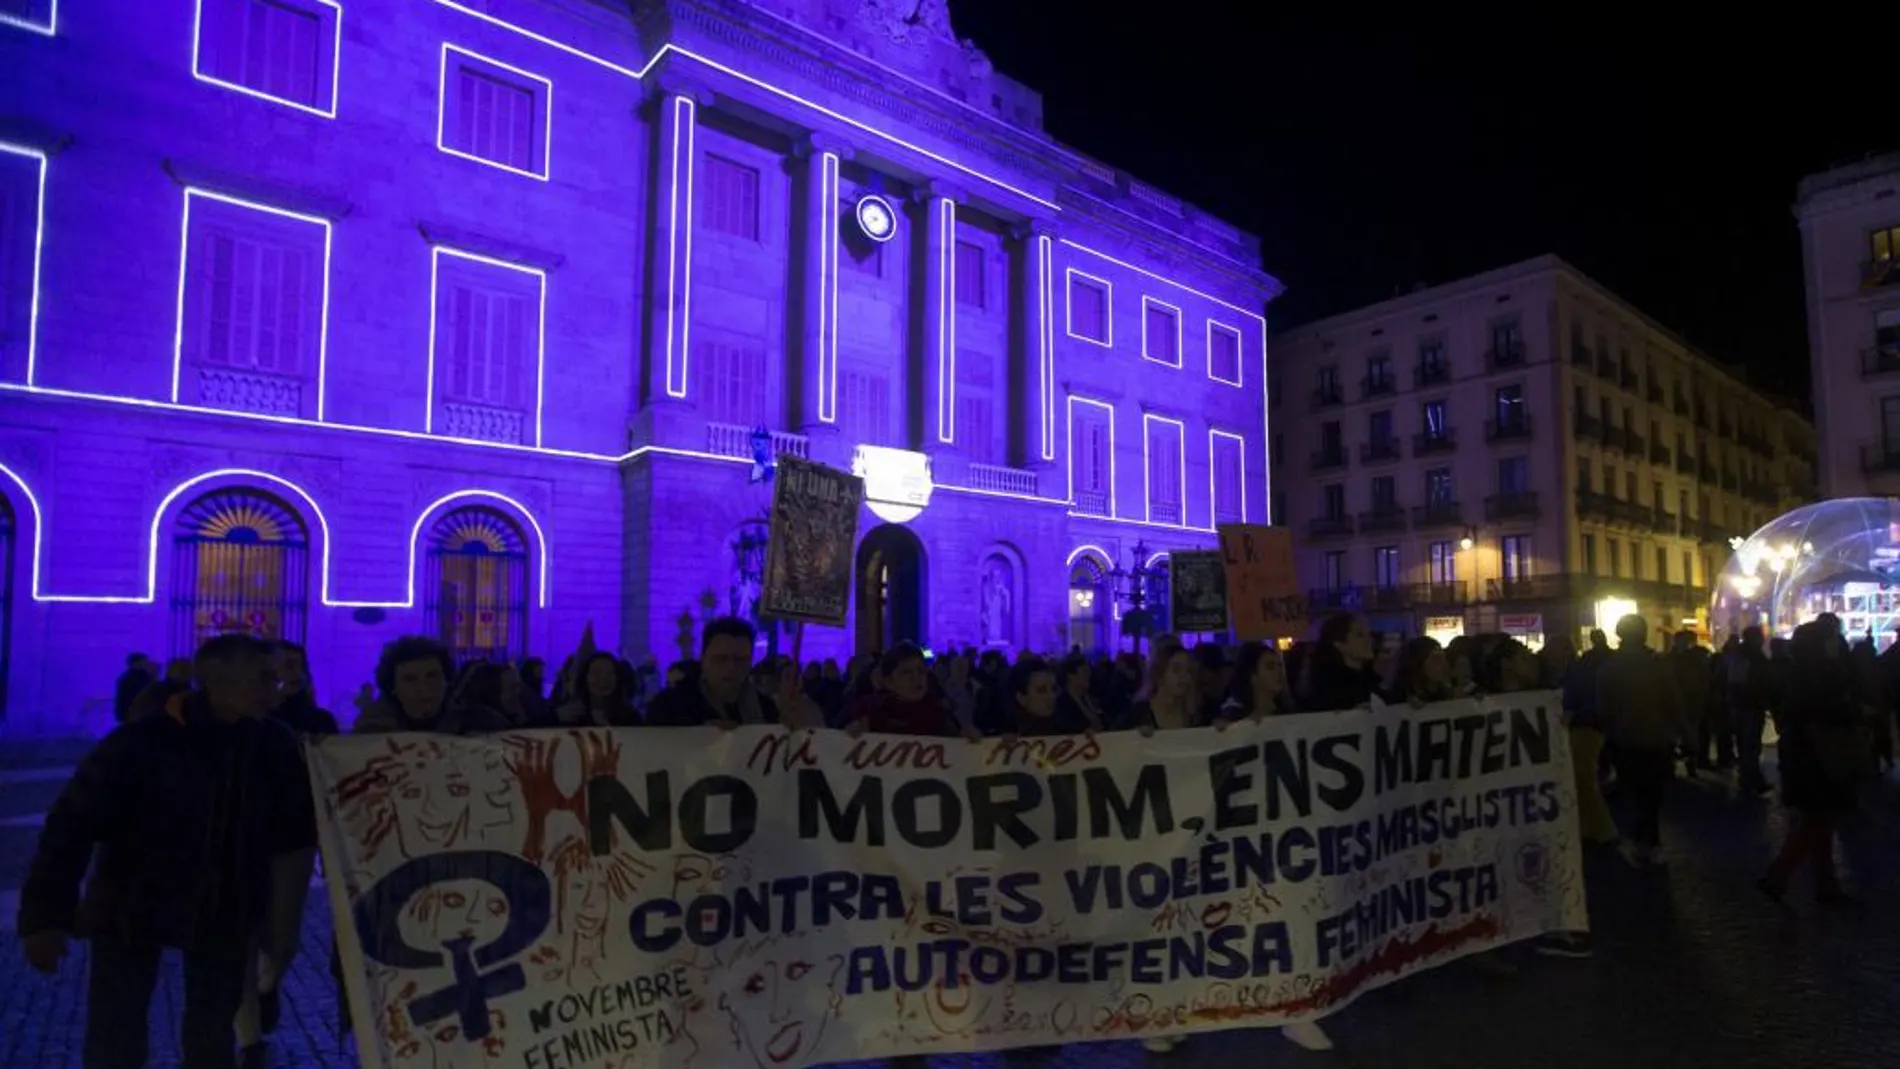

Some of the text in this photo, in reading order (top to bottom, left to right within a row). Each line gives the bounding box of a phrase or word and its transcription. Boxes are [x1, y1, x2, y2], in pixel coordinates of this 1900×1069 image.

[588, 706, 1550, 857] NO MORIM, ENS MATEN
[747, 729, 817, 777] ni
[845, 737, 951, 769] una
[629, 871, 906, 953] CONTRA
[926, 872, 1043, 926] LES
[1064, 819, 1373, 915] VIOLÈNCIES
[846, 863, 1498, 995] AUTODEFENSA FEMINISTA
[524, 1010, 673, 1069] FEMINISTA
[529, 967, 693, 1034] NOVEMBRE
